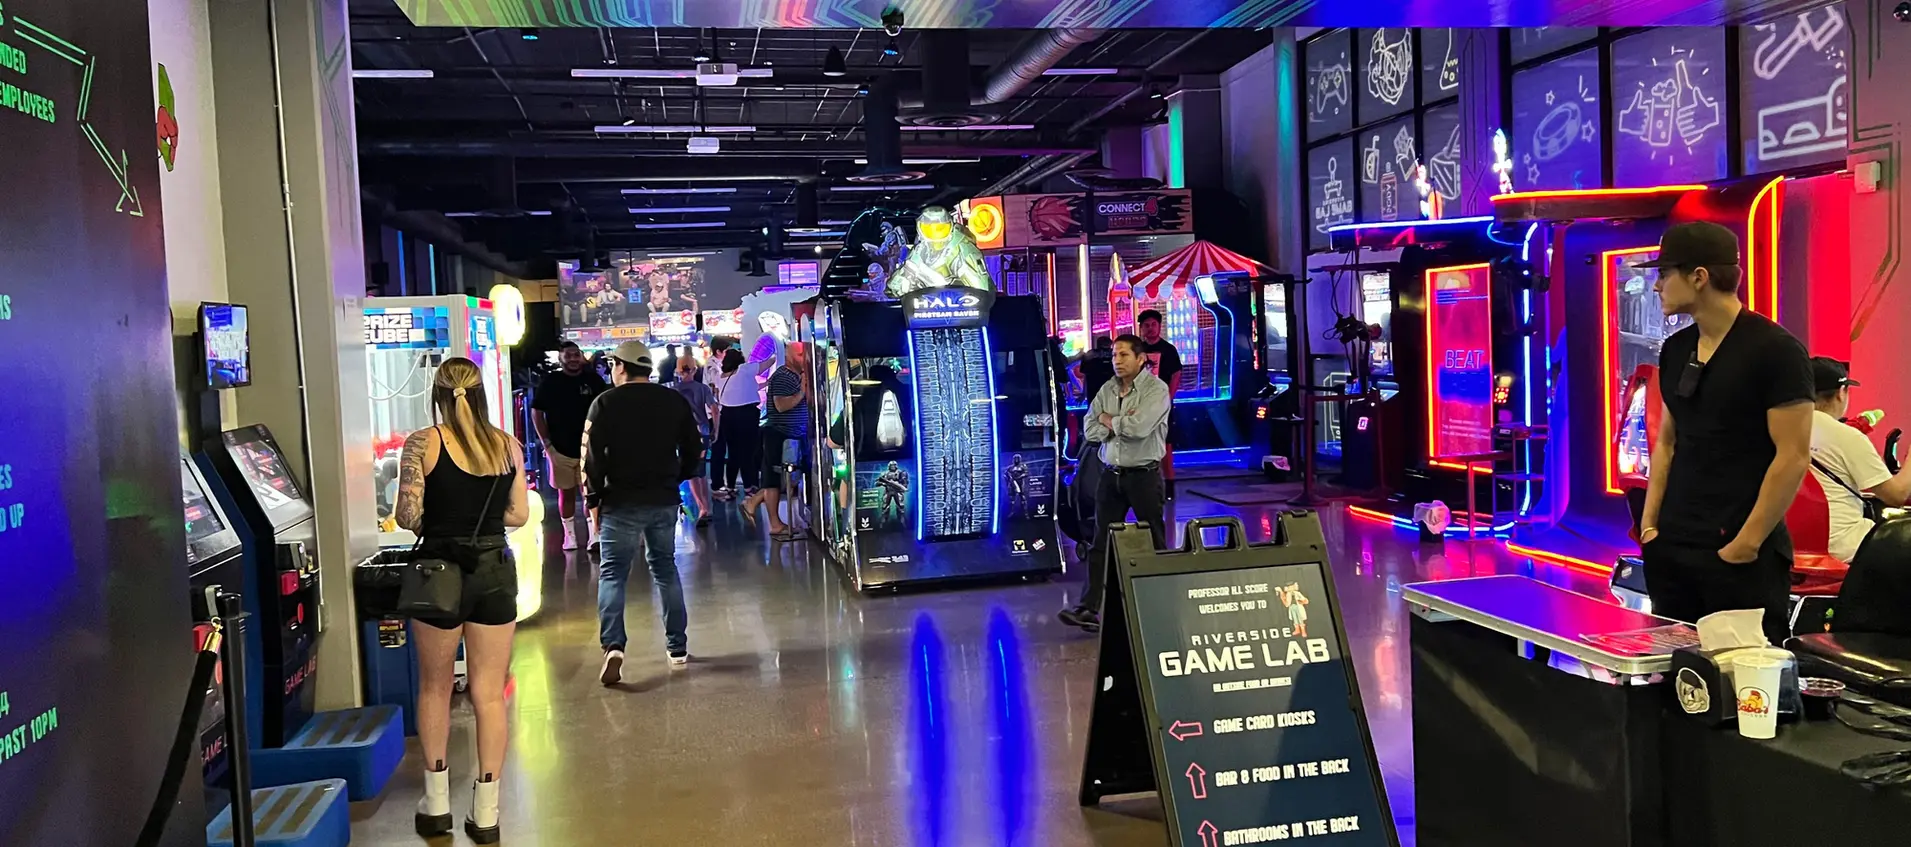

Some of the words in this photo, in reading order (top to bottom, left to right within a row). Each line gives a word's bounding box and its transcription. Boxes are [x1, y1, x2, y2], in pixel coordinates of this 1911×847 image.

[0, 81, 56, 123] MPLOYEES
[1098, 203, 1146, 213] CONNECT
[913, 295, 980, 309] HALO
[1445, 350, 1484, 369] BEAT
[9, 502, 24, 529] UP
[1188, 586, 1230, 599] PROFESSOR
[1244, 583, 1269, 594] SCORE
[1199, 602, 1239, 614] WELCOMES
[1240, 600, 1256, 611] YOU
[1257, 599, 1267, 609] TO
[1191, 627, 1293, 646] RIVERSIDE
[1158, 644, 1255, 677] GAME
[1261, 638, 1330, 667] LAB
[1213, 717, 1243, 734] GAME
[1245, 714, 1275, 730] CARD
[1277, 710, 1316, 728] KIOSKS
[0, 723, 26, 765] PAST
[30, 706, 58, 743] 10PM
[1215, 770, 1238, 787] BAR
[1252, 766, 1281, 783] FOOD
[1283, 764, 1295, 779] IN
[1297, 761, 1319, 778] THE
[1320, 758, 1350, 775] BACK
[1223, 824, 1290, 846] BATHROOMS
[1292, 822, 1304, 838] IN
[1305, 819, 1328, 836] THE
[1329, 815, 1360, 834] BACK
